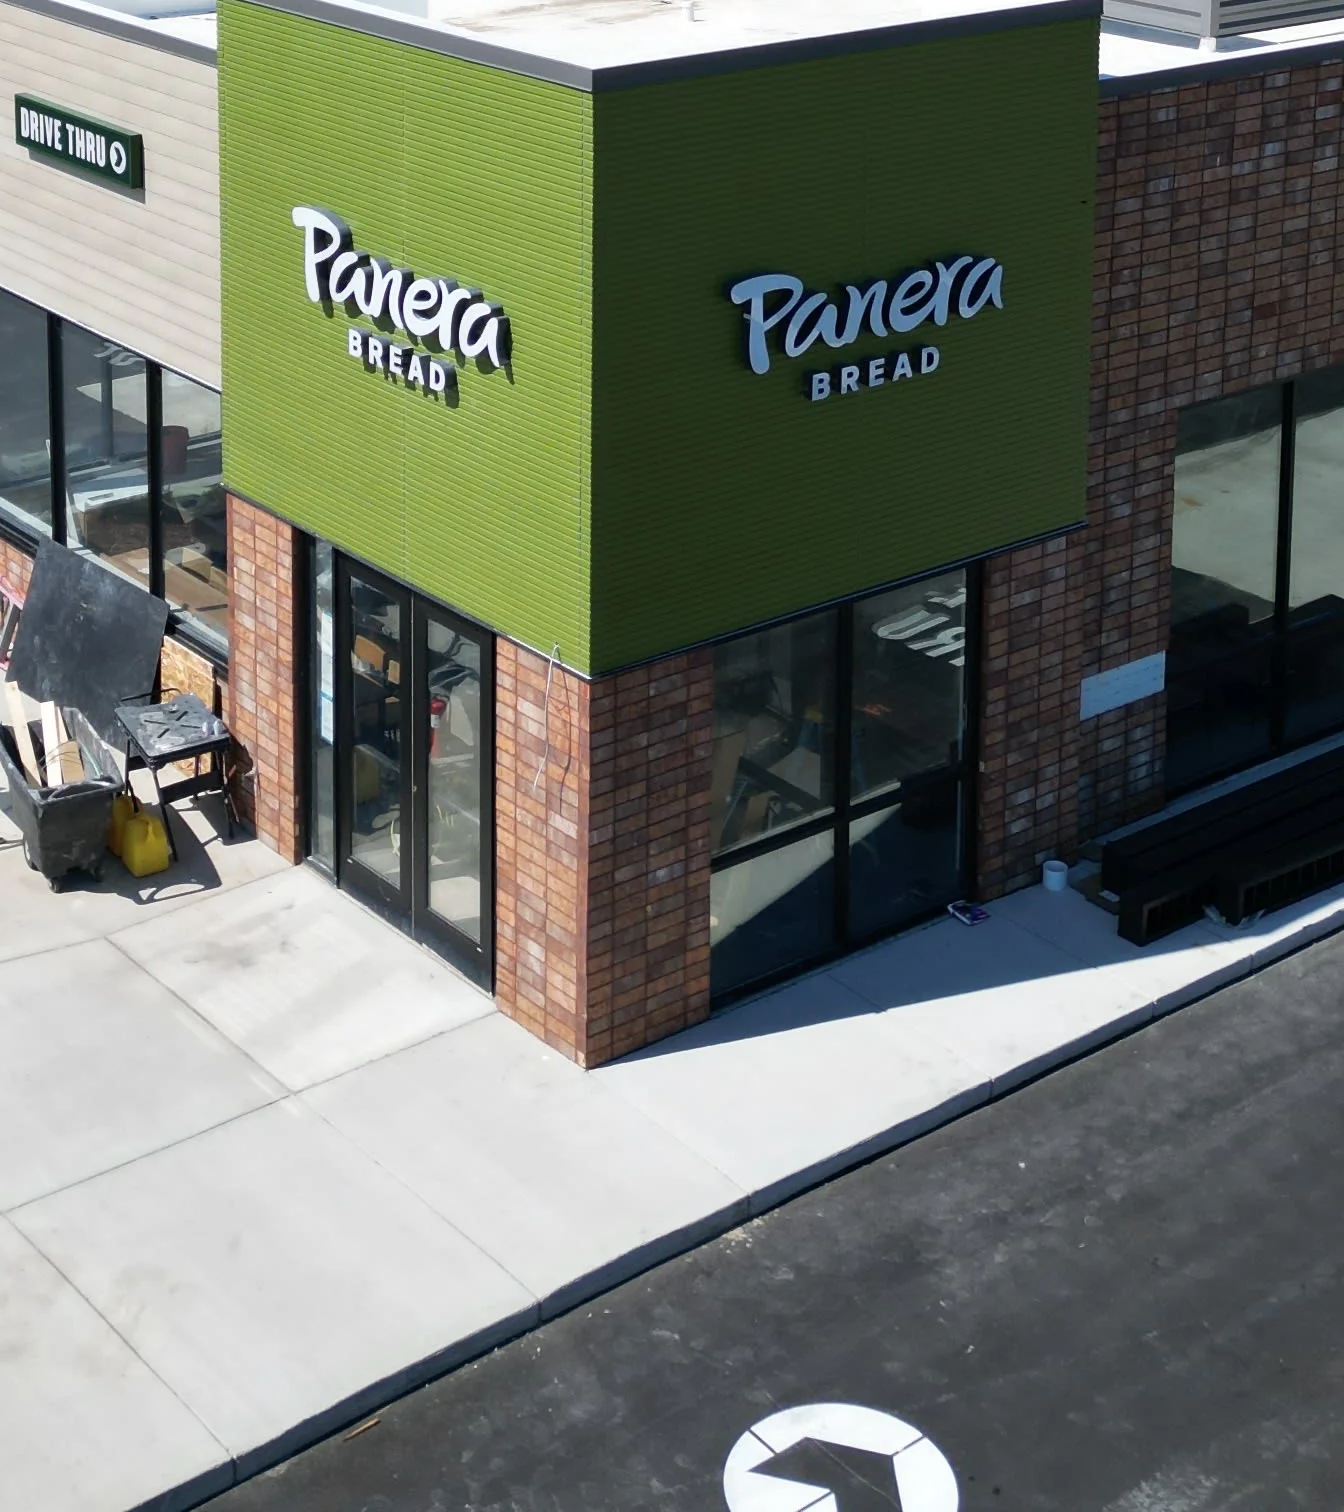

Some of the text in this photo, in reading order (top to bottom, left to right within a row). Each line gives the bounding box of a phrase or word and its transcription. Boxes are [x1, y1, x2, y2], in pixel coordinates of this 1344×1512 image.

[20, 106, 106, 167] DRIVE THRU
[292, 206, 500, 368] Panera
[730, 256, 1003, 375] Panera
[348, 329, 446, 392] BREAD
[812, 346, 940, 401] BREAD
